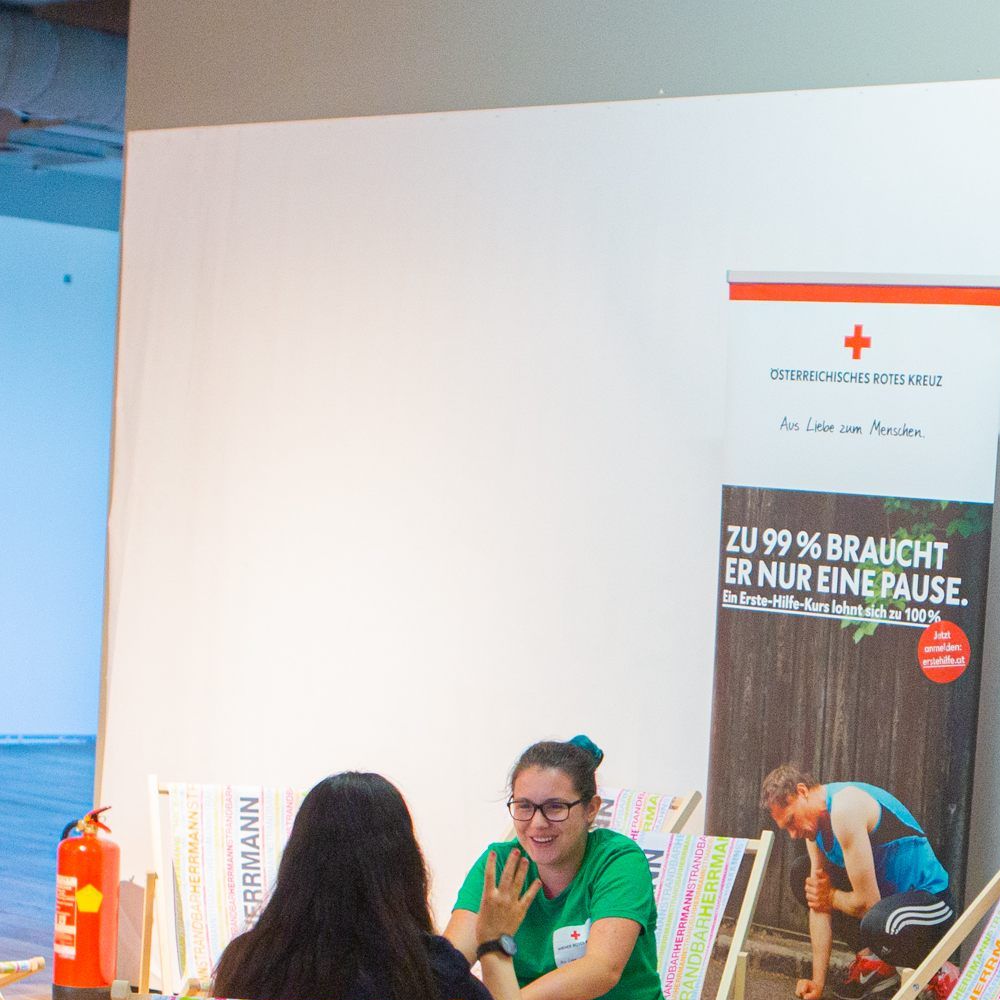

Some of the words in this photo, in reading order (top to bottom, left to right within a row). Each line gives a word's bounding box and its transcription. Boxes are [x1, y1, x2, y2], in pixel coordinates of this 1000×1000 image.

[769, 367, 871, 385] ÖSTERREICHISCHES
[873, 373, 905, 386] ROTES
[908, 374, 943, 387] KREUZ
[779, 416, 800, 432] Aus
[806, 417, 835, 433] Liebe
[839, 423, 862, 435] zum
[869, 419, 926, 439] Menschen.
[725, 525, 758, 553] ZU
[826, 533, 949, 571] BRAUCHT
[724, 557, 753, 587] ER
[757, 560, 812, 592] NUR
[817, 565, 876, 598] EINE
[880, 570, 969, 608] PAUSE.
[722, 590, 738, 605] Ein
[739, 591, 830, 613] Erste-Hilfe-Kurs
[831, 603, 864, 618] lohnt
[865, 606, 888, 620] sich
[888, 611, 902, 621] zu
